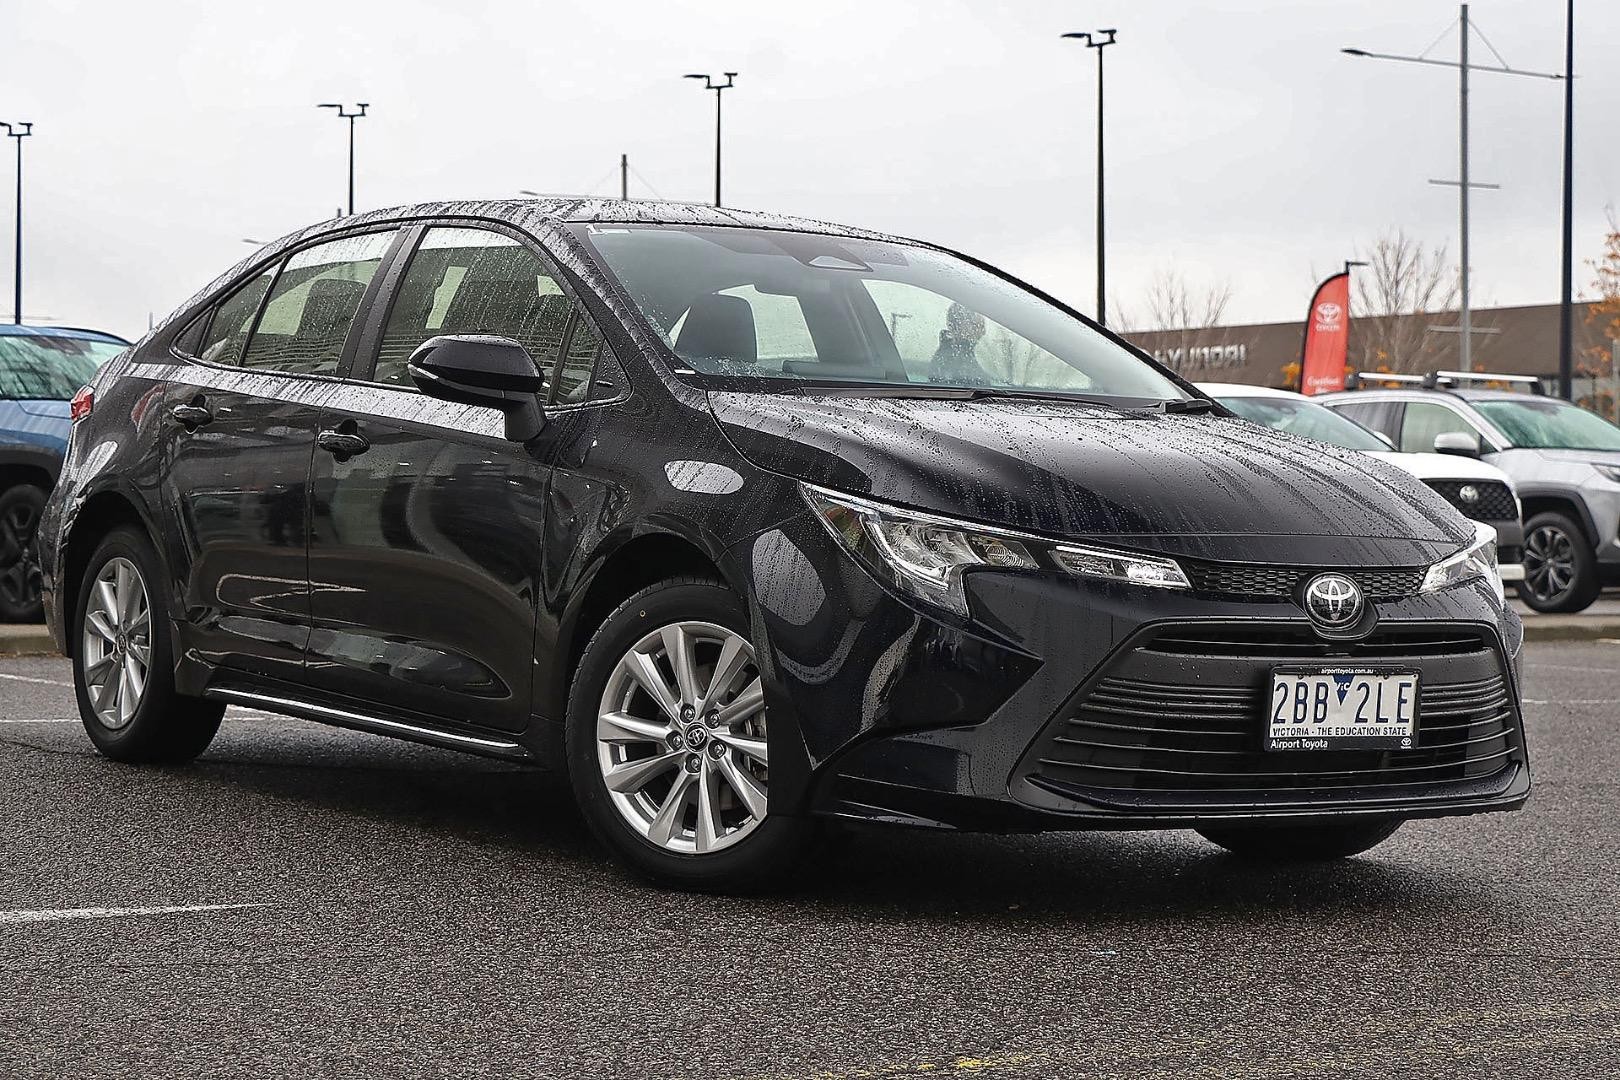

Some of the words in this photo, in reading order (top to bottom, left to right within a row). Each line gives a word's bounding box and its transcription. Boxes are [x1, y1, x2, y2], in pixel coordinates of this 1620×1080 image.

[1320, 667, 1374, 675] airporttoyota.com.au
[1272, 682, 1329, 724] 2BB
[1354, 682, 1412, 724] 2LE
[1273, 727, 1309, 736] VICTORIA
[1317, 727, 1332, 736] THE
[1335, 727, 1380, 736] EDUCATION
[1383, 727, 1407, 736] STATE
[1270, 738, 1300, 750] Airport
[1301, 738, 1328, 750] Toyota
